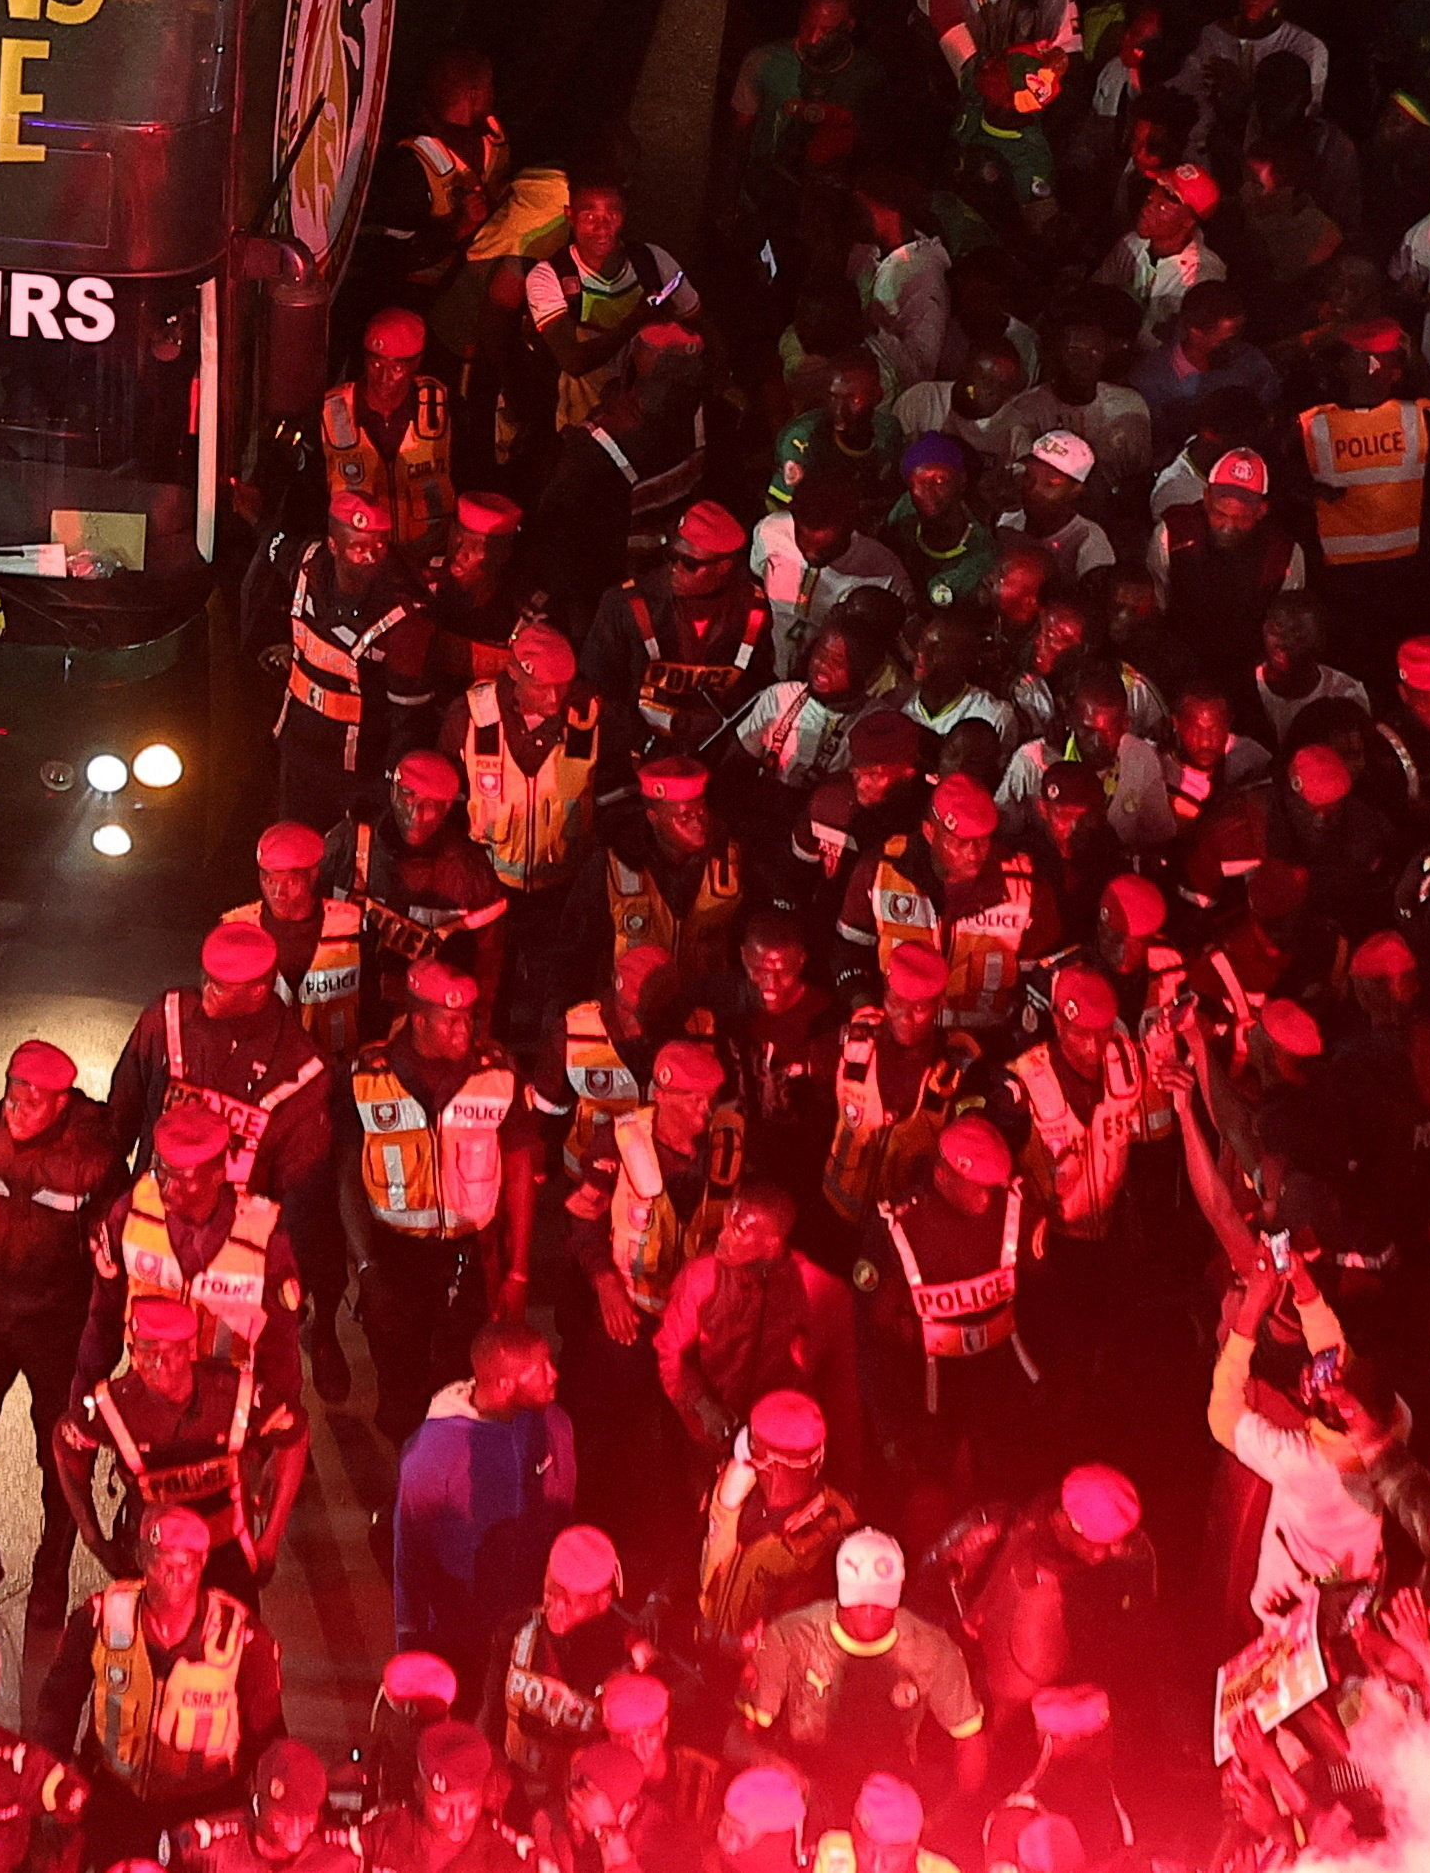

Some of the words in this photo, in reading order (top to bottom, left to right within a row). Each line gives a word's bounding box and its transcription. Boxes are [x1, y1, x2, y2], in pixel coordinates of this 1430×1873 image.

[1335, 431, 1402, 459] POLICE
[305, 970, 358, 995] POLICE
[453, 1104, 504, 1121] POLICE
[918, 1270, 1013, 1314] POLICE
